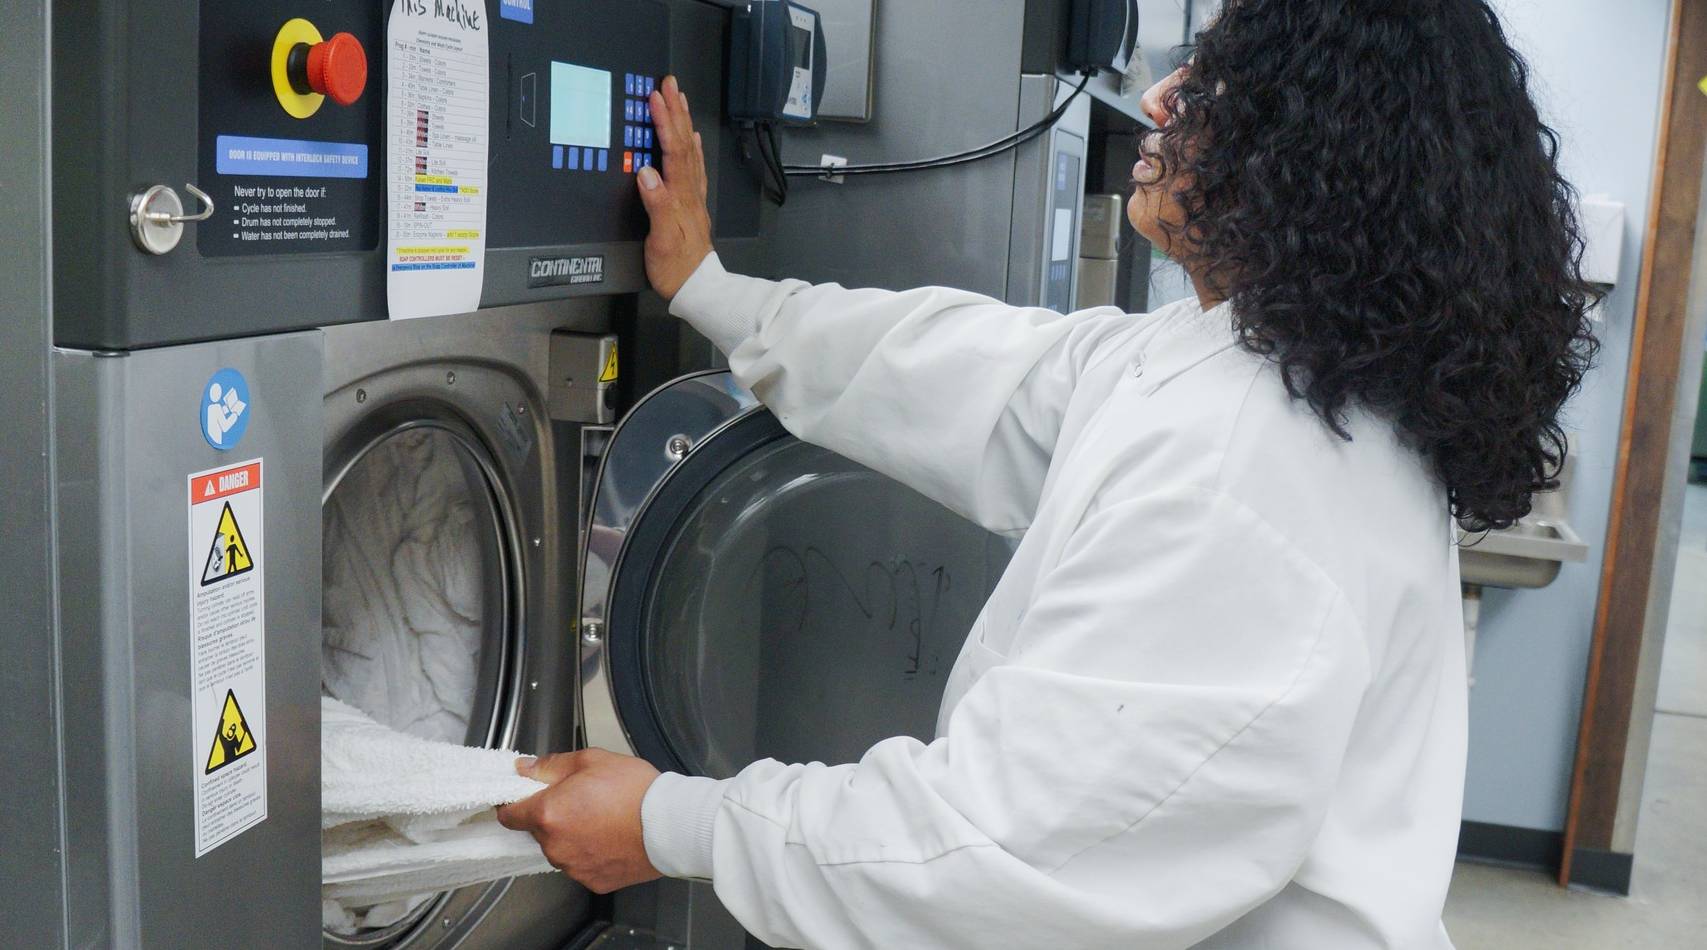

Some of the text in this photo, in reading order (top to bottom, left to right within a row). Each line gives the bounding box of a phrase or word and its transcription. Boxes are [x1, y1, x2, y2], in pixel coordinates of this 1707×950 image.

[228, 149, 359, 165] DOOR IS EQUIPPED WITH INTERLOCK SAFETY DEVICE
[234, 185, 256, 198] Never
[257, 186, 266, 200] try
[267, 186, 274, 198] to
[275, 187, 293, 200] open
[293, 186, 304, 198] the
[304, 187, 320, 198] door
[241, 203, 307, 215] Cycle has not finished.
[241, 217, 337, 228] Drum has not completely stopped.
[241, 229, 350, 241] Water has not been completely drained.
[531, 257, 603, 278] CONTINENTAL
[219, 470, 249, 492] DANGER
